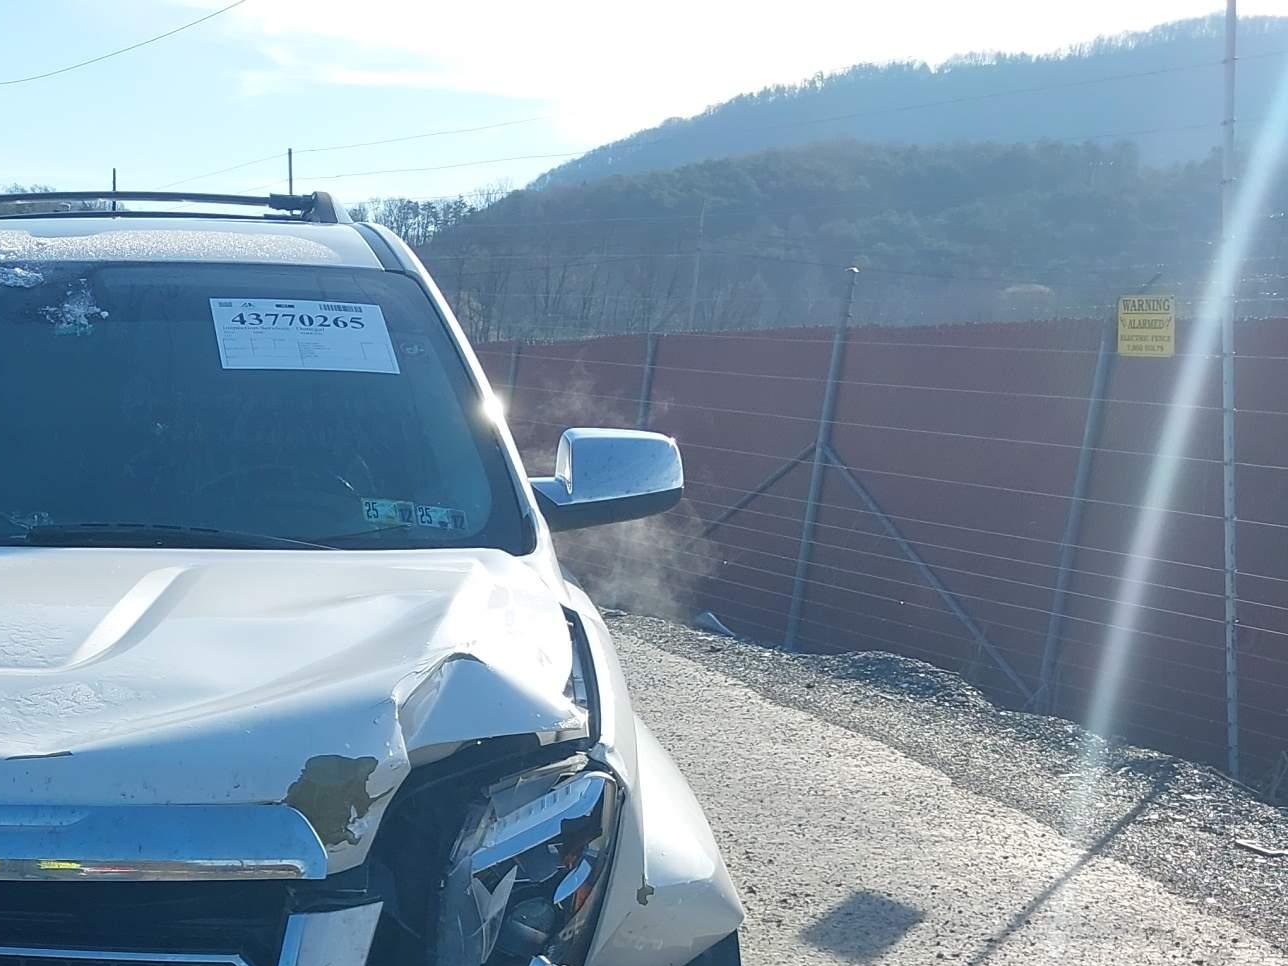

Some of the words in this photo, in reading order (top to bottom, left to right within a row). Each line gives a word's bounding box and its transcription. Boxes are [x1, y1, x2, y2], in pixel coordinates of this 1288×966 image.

[1122, 299, 1170, 312] WARNING
[231, 312, 365, 329] 43770265
[364, 502, 379, 519] 25
[417, 507, 433, 524] 25
